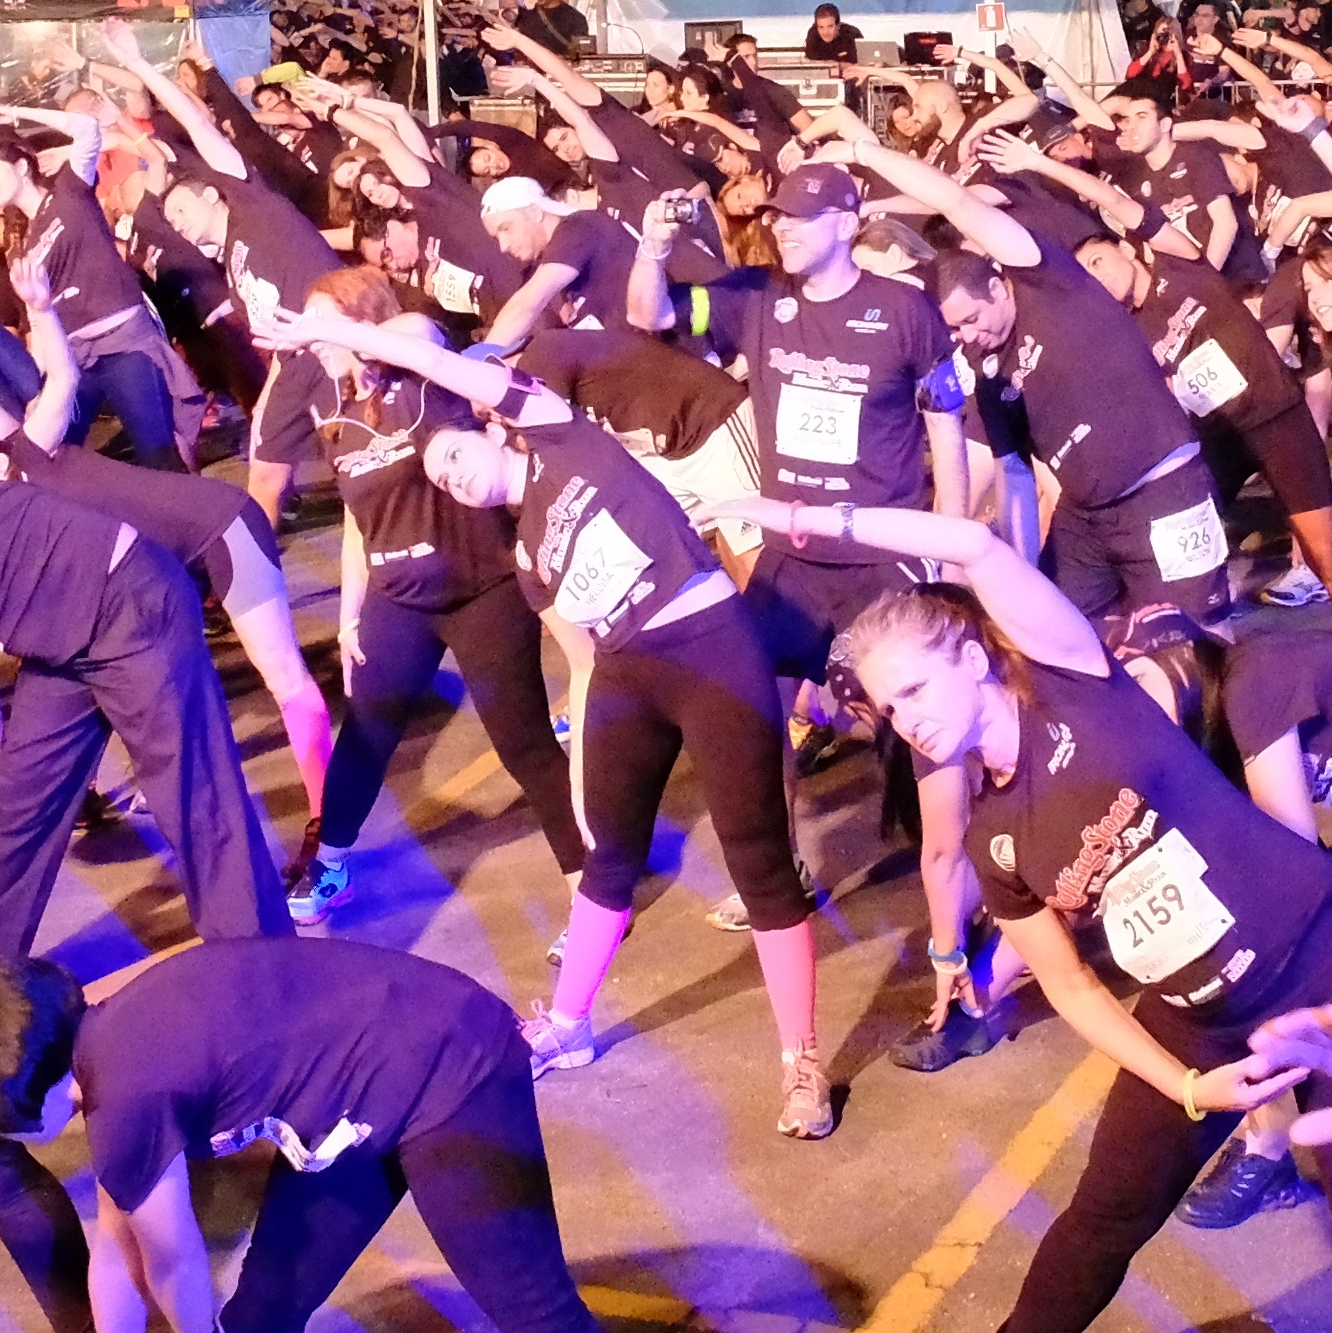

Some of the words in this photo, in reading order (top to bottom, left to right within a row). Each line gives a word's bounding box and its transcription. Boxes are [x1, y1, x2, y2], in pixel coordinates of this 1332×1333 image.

[1187, 366, 1218, 395] 506
[798, 411, 838, 435] 223
[1177, 526, 1211, 554] 926
[565, 547, 606, 602] 1067
[1080, 787, 1140, 853] Stone
[1122, 883, 1185, 949] 2159
